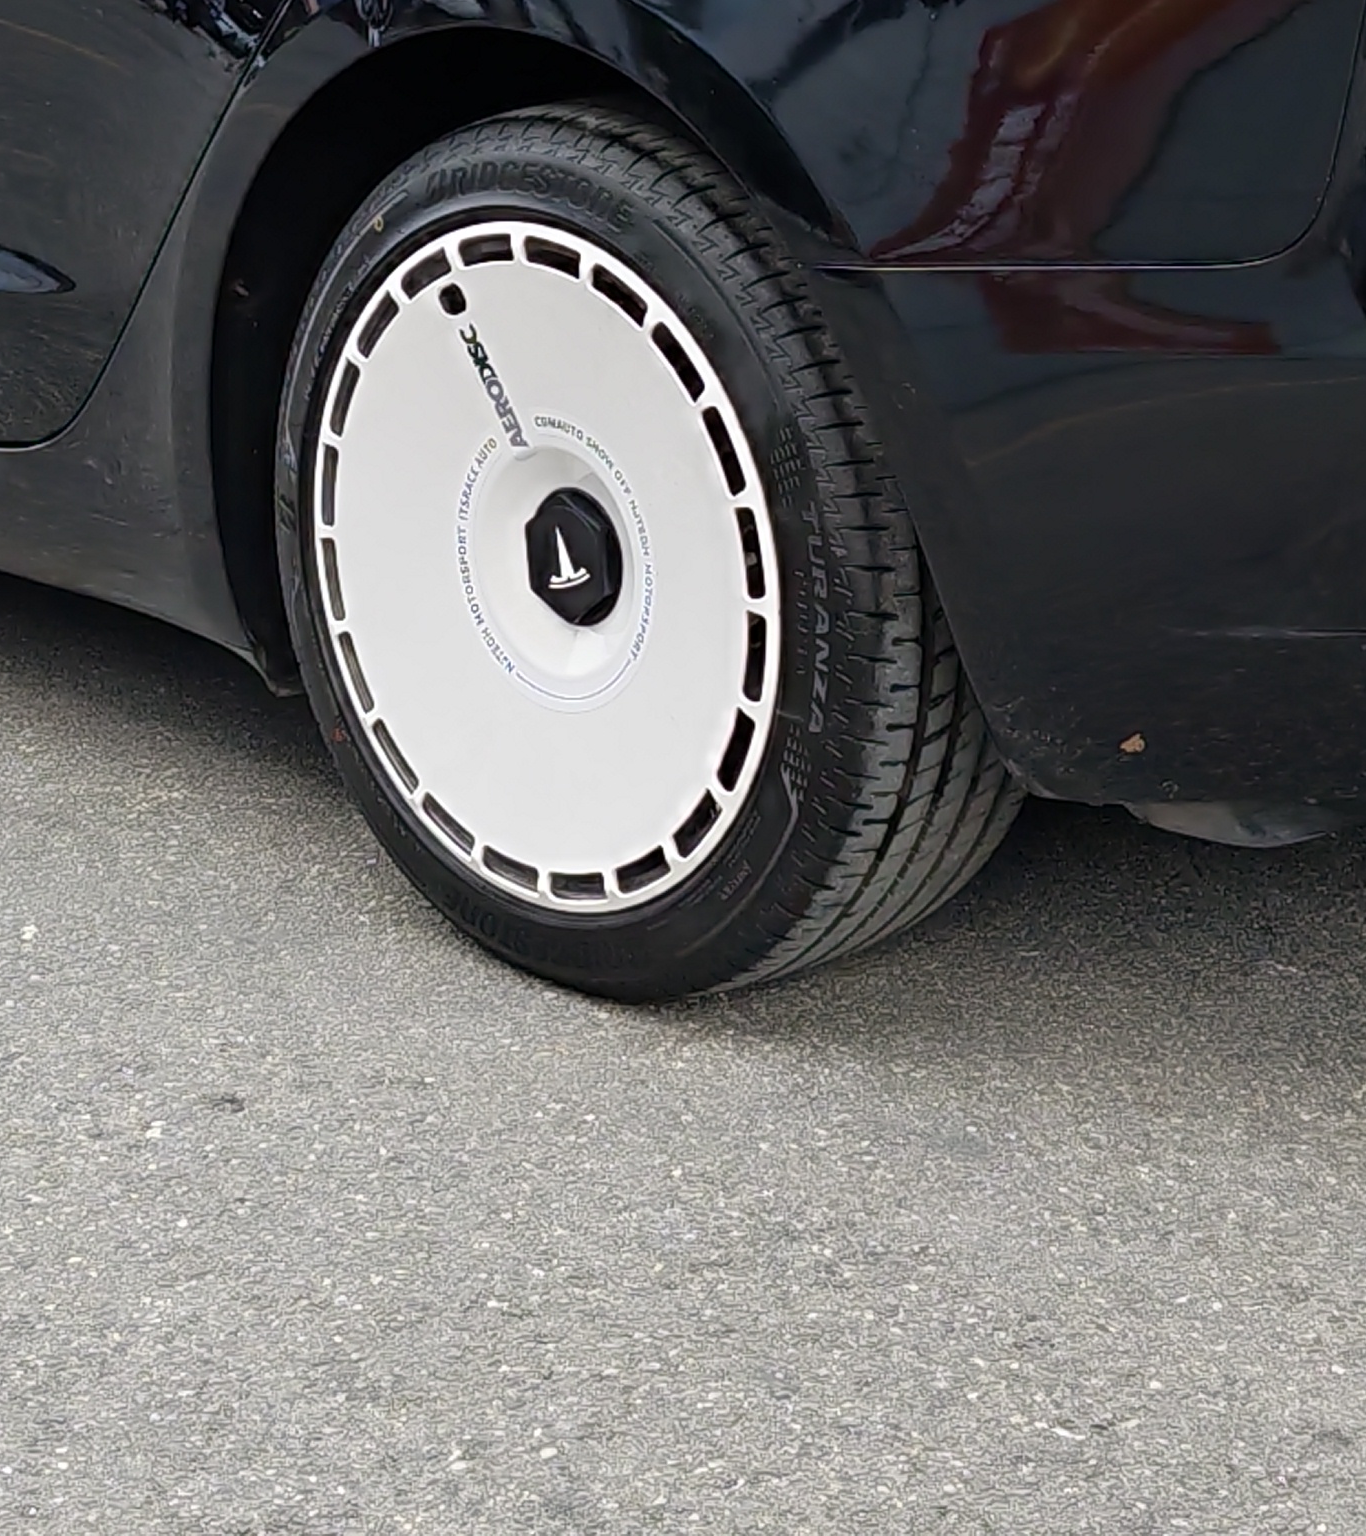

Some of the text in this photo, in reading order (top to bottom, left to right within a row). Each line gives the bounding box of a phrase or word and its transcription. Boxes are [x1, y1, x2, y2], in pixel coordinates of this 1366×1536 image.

[458, 322, 530, 448] AERODISC
[476, 437, 498, 468] AUTO
[801, 500, 832, 733] TURANZA
